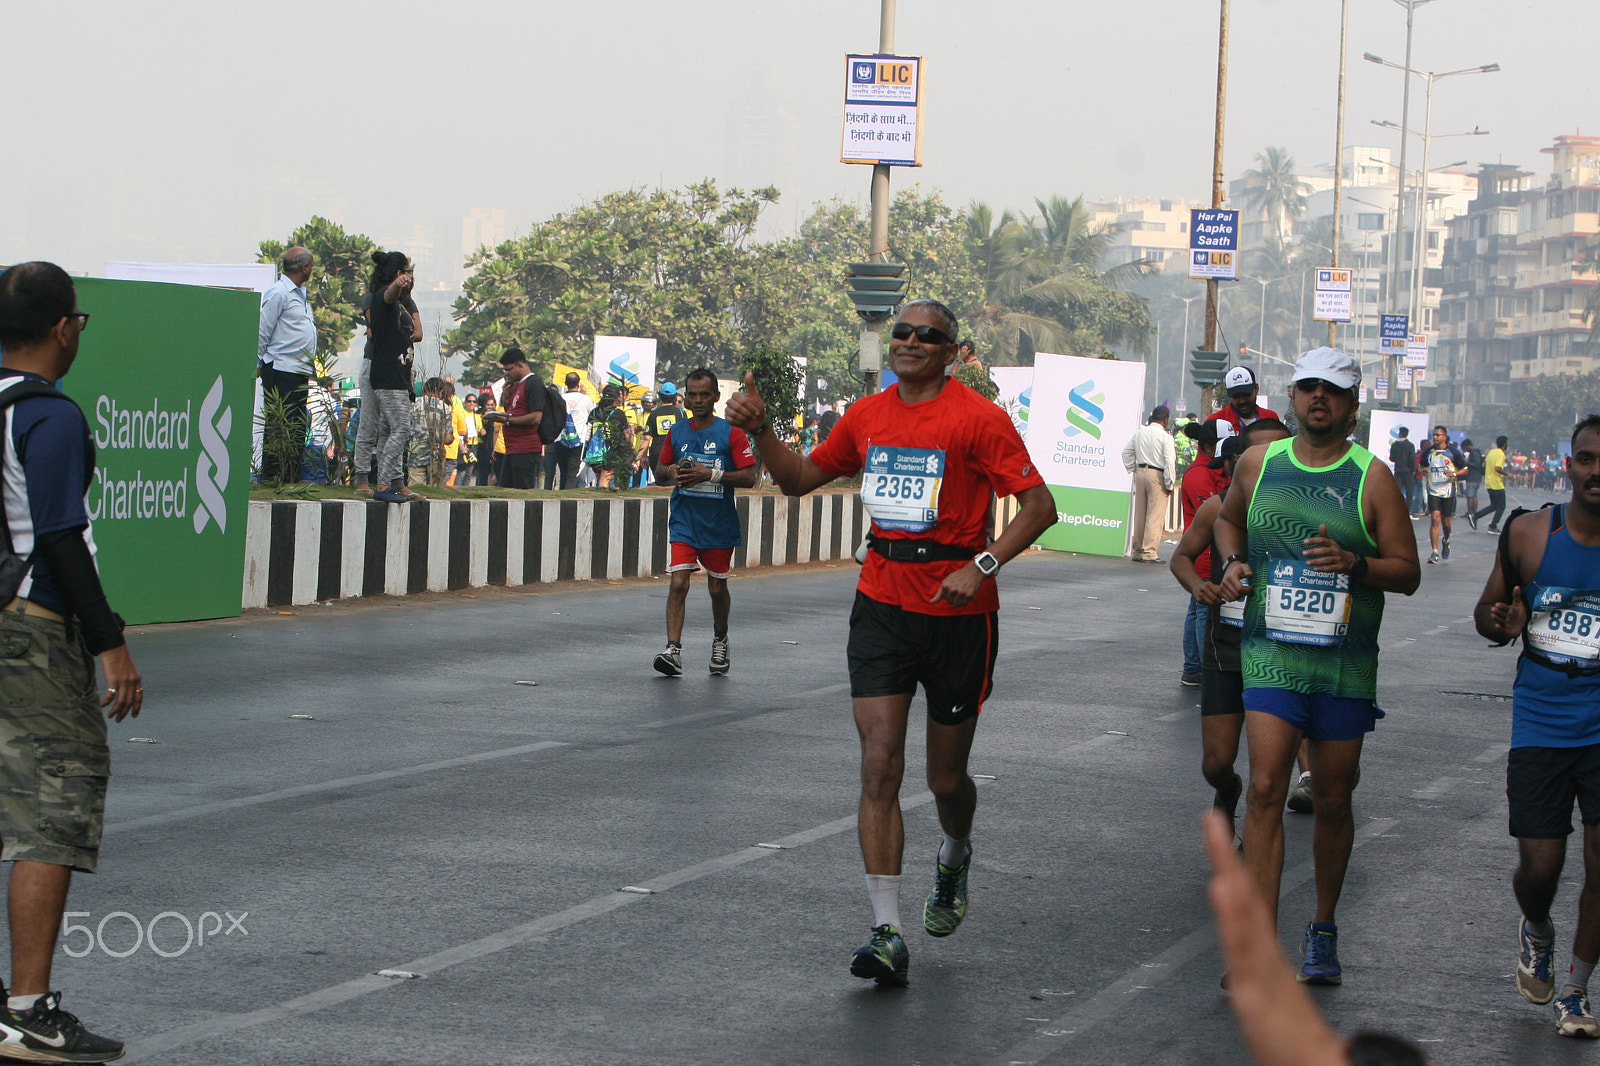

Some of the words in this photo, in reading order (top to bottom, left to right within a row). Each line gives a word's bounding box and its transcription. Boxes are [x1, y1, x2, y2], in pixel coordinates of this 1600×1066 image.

[880, 65, 909, 83] LIC
[870, 112, 878, 124] के
[880, 115, 896, 124] साथ
[876, 130, 884, 141] के
[902, 131, 912, 142] भी
[1198, 212, 1215, 220] Har
[1216, 213, 1232, 221] Pal
[1196, 223, 1232, 235] Aapke
[1198, 236, 1230, 246] Saath
[1211, 252, 1230, 264] LIC
[1332, 272, 1347, 282] LIC
[95, 395, 190, 450] Standard
[1056, 440, 1105, 455] Standard
[896, 454, 926, 464] Standard
[1052, 452, 1106, 468] Chartered
[894, 462, 924, 472] Chartered
[83, 466, 188, 521] Chartered
[875, 476, 925, 500] 2363
[926, 510, 934, 520] B
[1056, 512, 1122, 528] StepCloser
[1302, 568, 1334, 578] Standard
[1299, 576, 1334, 586] Chartered
[1280, 588, 1335, 614] 5220
[1338, 624, 1346, 635] C
